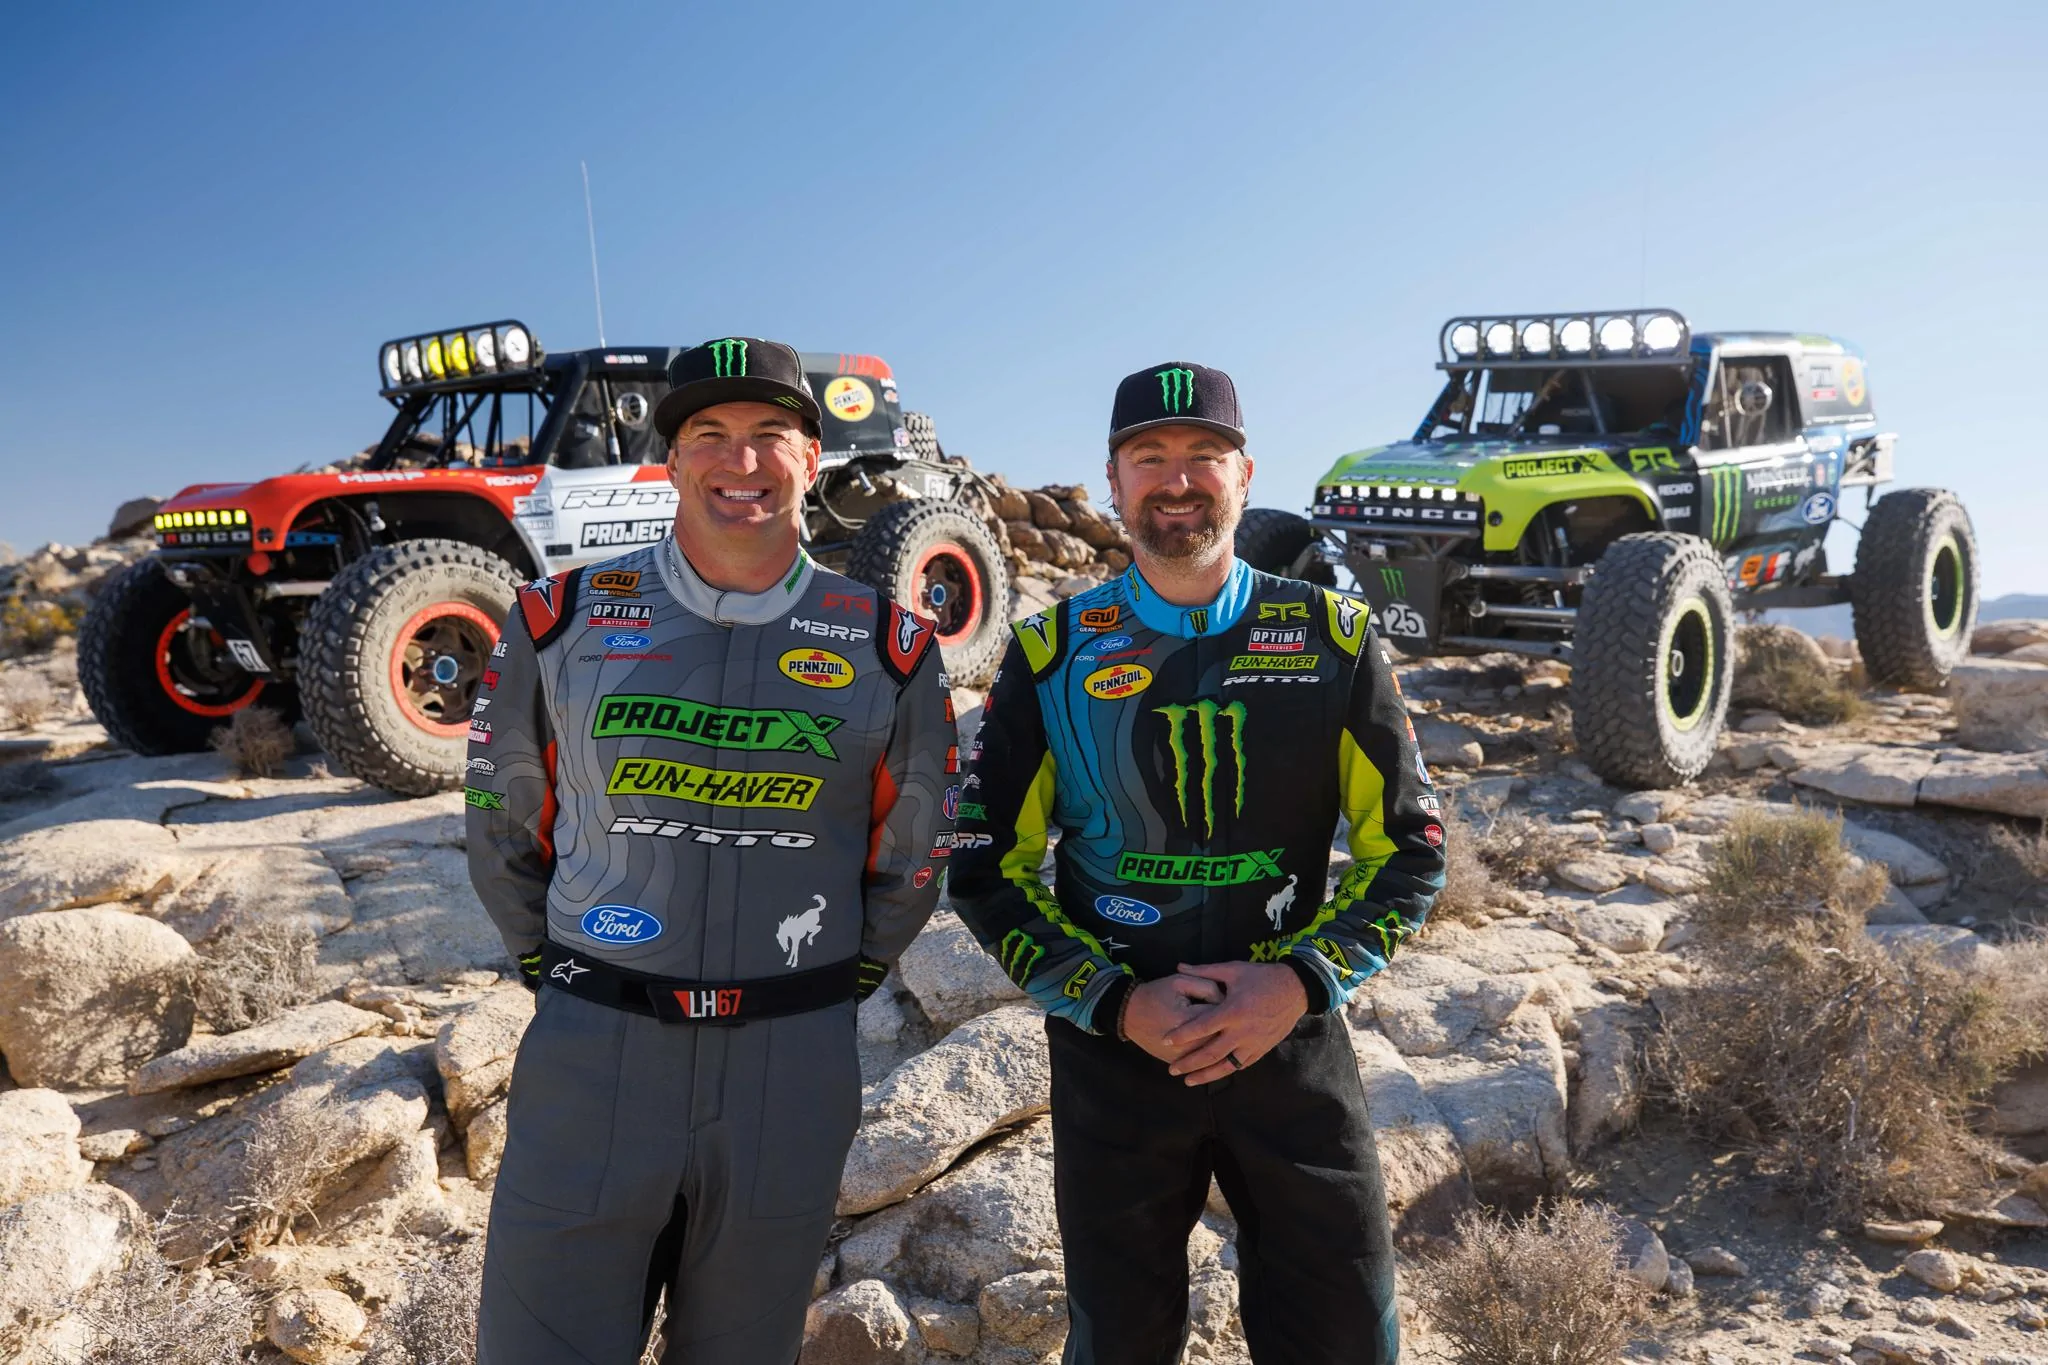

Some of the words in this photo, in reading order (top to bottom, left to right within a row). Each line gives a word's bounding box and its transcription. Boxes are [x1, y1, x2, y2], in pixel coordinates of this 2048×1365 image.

[1313, 503, 1478, 522] BRONCO
[588, 588, 641, 598] GEARWRENCH
[592, 603, 651, 619] OPTIMA
[601, 619, 639, 627] BATTERIES
[1387, 606, 1420, 635] 25
[789, 616, 870, 642] MBRP
[1252, 630, 1303, 644] OPTIMA
[611, 634, 642, 647] Ford
[1100, 638, 1125, 650] Ford
[1231, 656, 1314, 669] FUN-HAVER
[1221, 674, 1321, 687] NITTO
[613, 761, 815, 806] FUN-HAVER
[607, 815, 818, 849] NITTO
[1106, 898, 1146, 923] Ford
[593, 909, 644, 939] Ford
